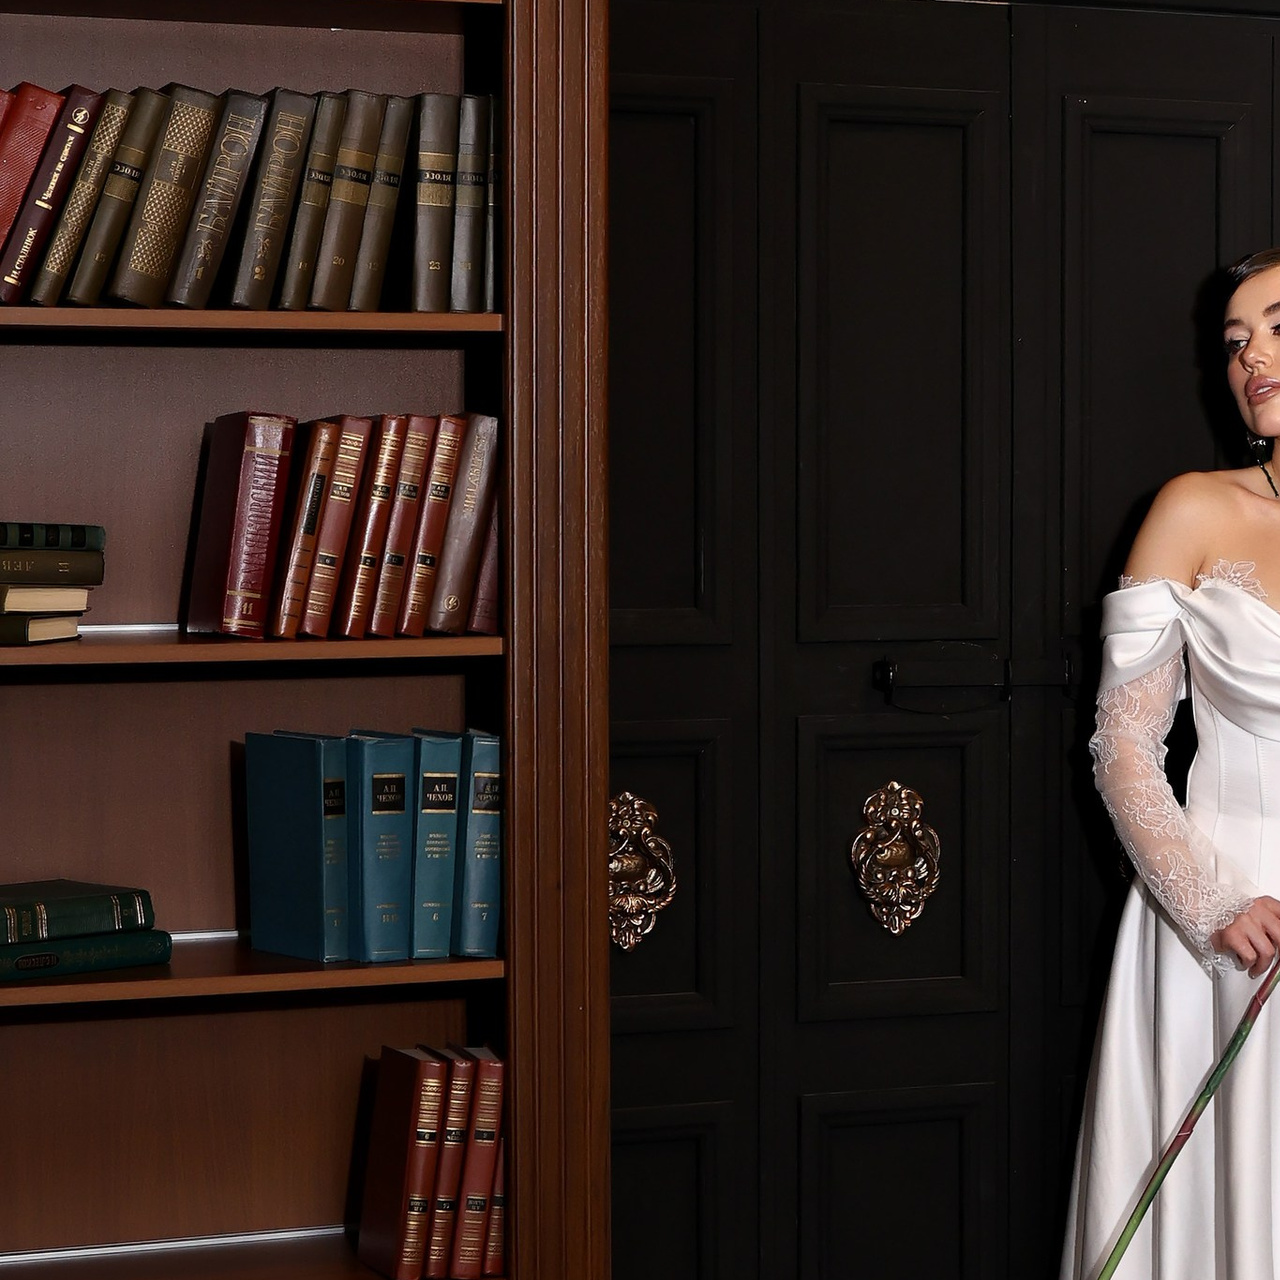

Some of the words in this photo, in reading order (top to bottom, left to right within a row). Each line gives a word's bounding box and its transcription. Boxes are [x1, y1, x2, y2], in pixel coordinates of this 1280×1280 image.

[197, 112, 257, 239] БАЙРОН
[254, 111, 307, 233] БАЙРОН
[428, 260, 442, 271] 23
[426, 792, 454, 802] ЧЕХОВ
